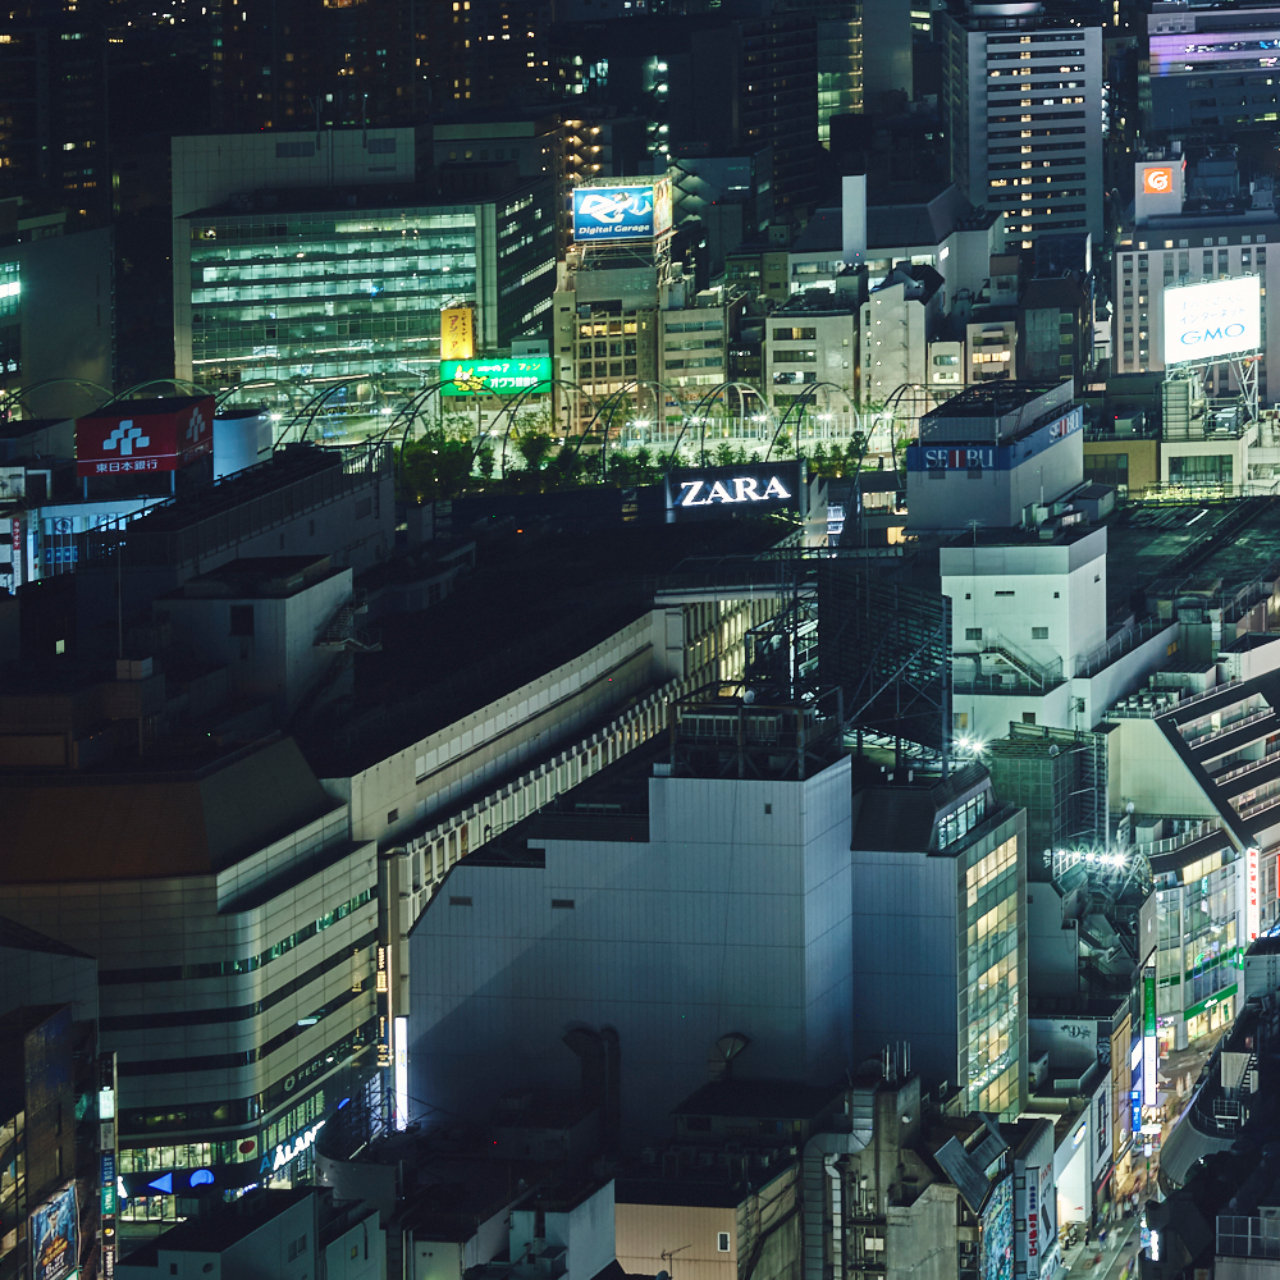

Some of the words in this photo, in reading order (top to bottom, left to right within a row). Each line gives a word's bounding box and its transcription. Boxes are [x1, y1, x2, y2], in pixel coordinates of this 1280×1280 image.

[578, 226, 612, 235] Digital
[614, 224, 650, 233] Garage
[1180, 323, 1246, 345] GMO
[96, 459, 158, 473] 東日本銀行
[925, 448, 994, 469] SEIBU
[680, 475, 792, 507] ZARA
